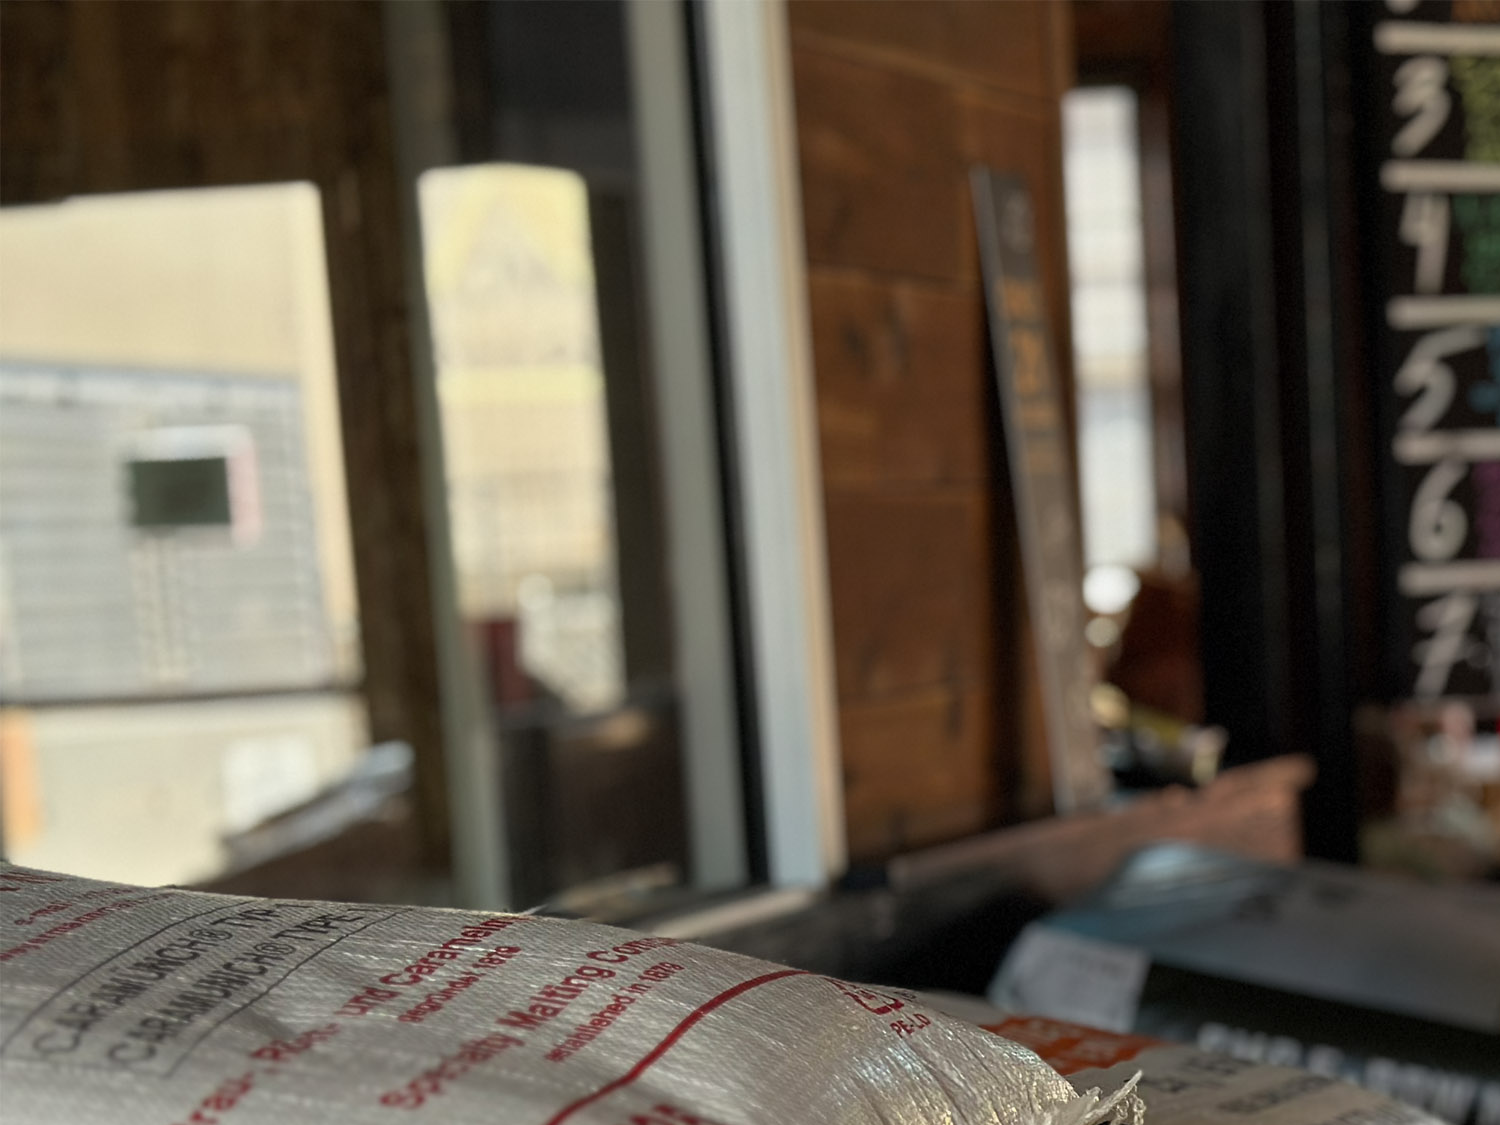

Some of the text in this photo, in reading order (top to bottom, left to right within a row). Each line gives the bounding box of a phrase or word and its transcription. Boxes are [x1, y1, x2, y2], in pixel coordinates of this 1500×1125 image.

[1393, 56, 1451, 157] 3
[1399, 194, 1451, 294] 4
[1394, 323, 1488, 436] 5
[1407, 458, 1468, 561] 6
[495, 965, 618, 1032] Malting
